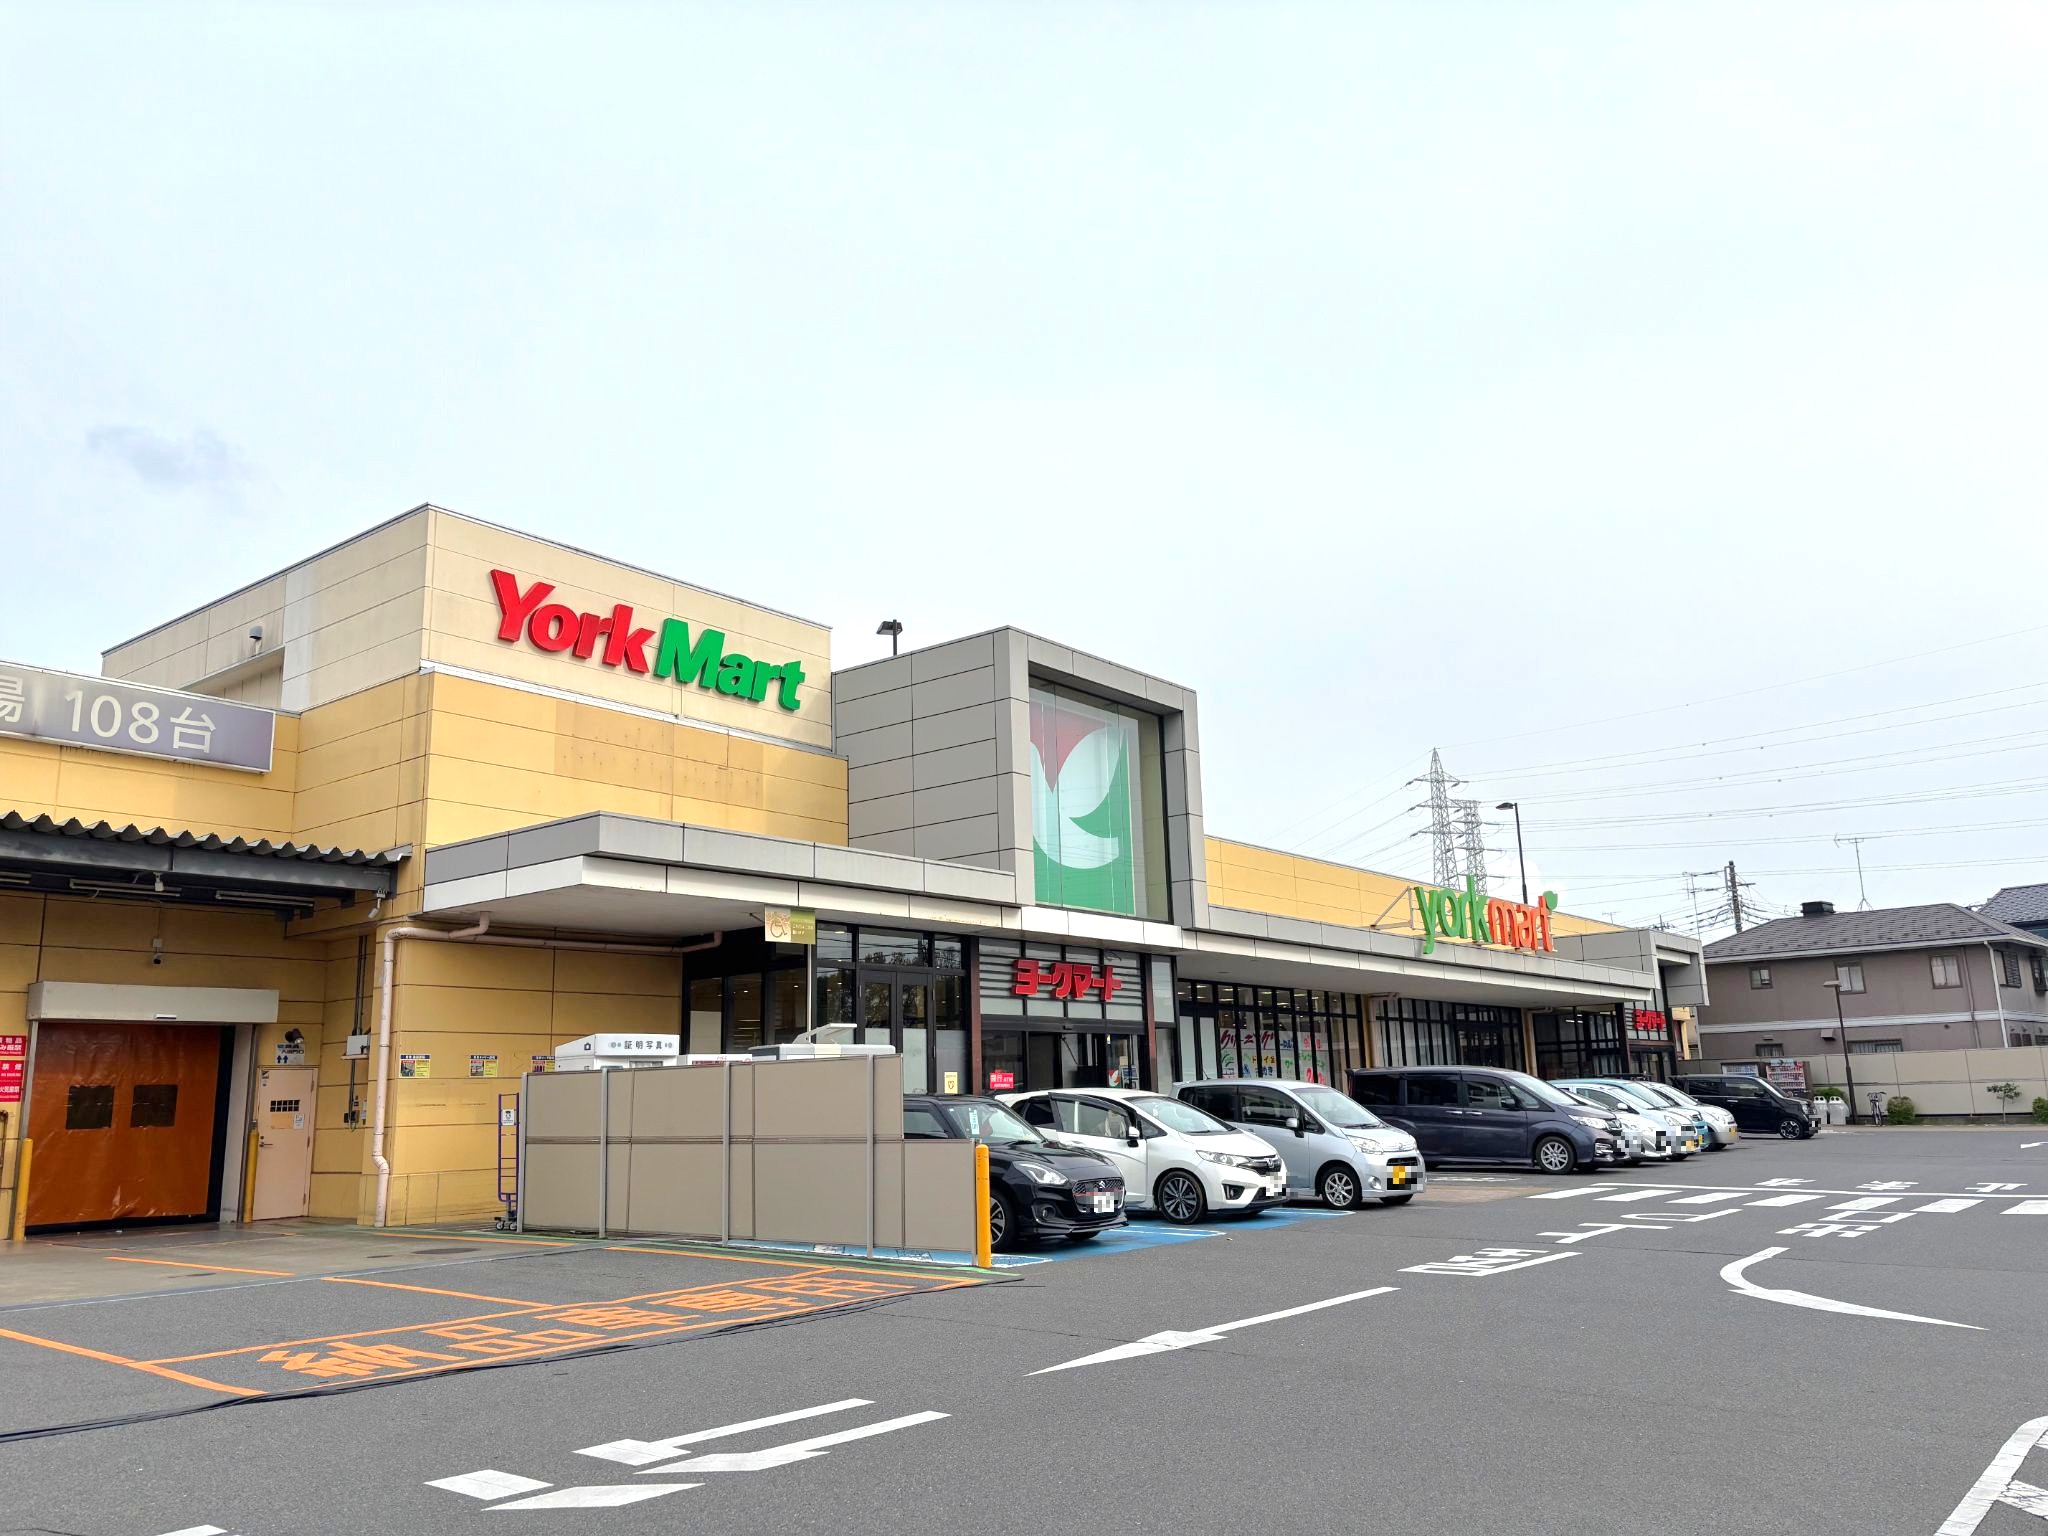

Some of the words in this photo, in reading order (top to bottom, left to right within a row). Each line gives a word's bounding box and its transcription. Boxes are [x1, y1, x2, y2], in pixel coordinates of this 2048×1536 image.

[1011, 959, 1122, 1001] ヨークマート
[624, 1040, 662, 1050] 証明写真
